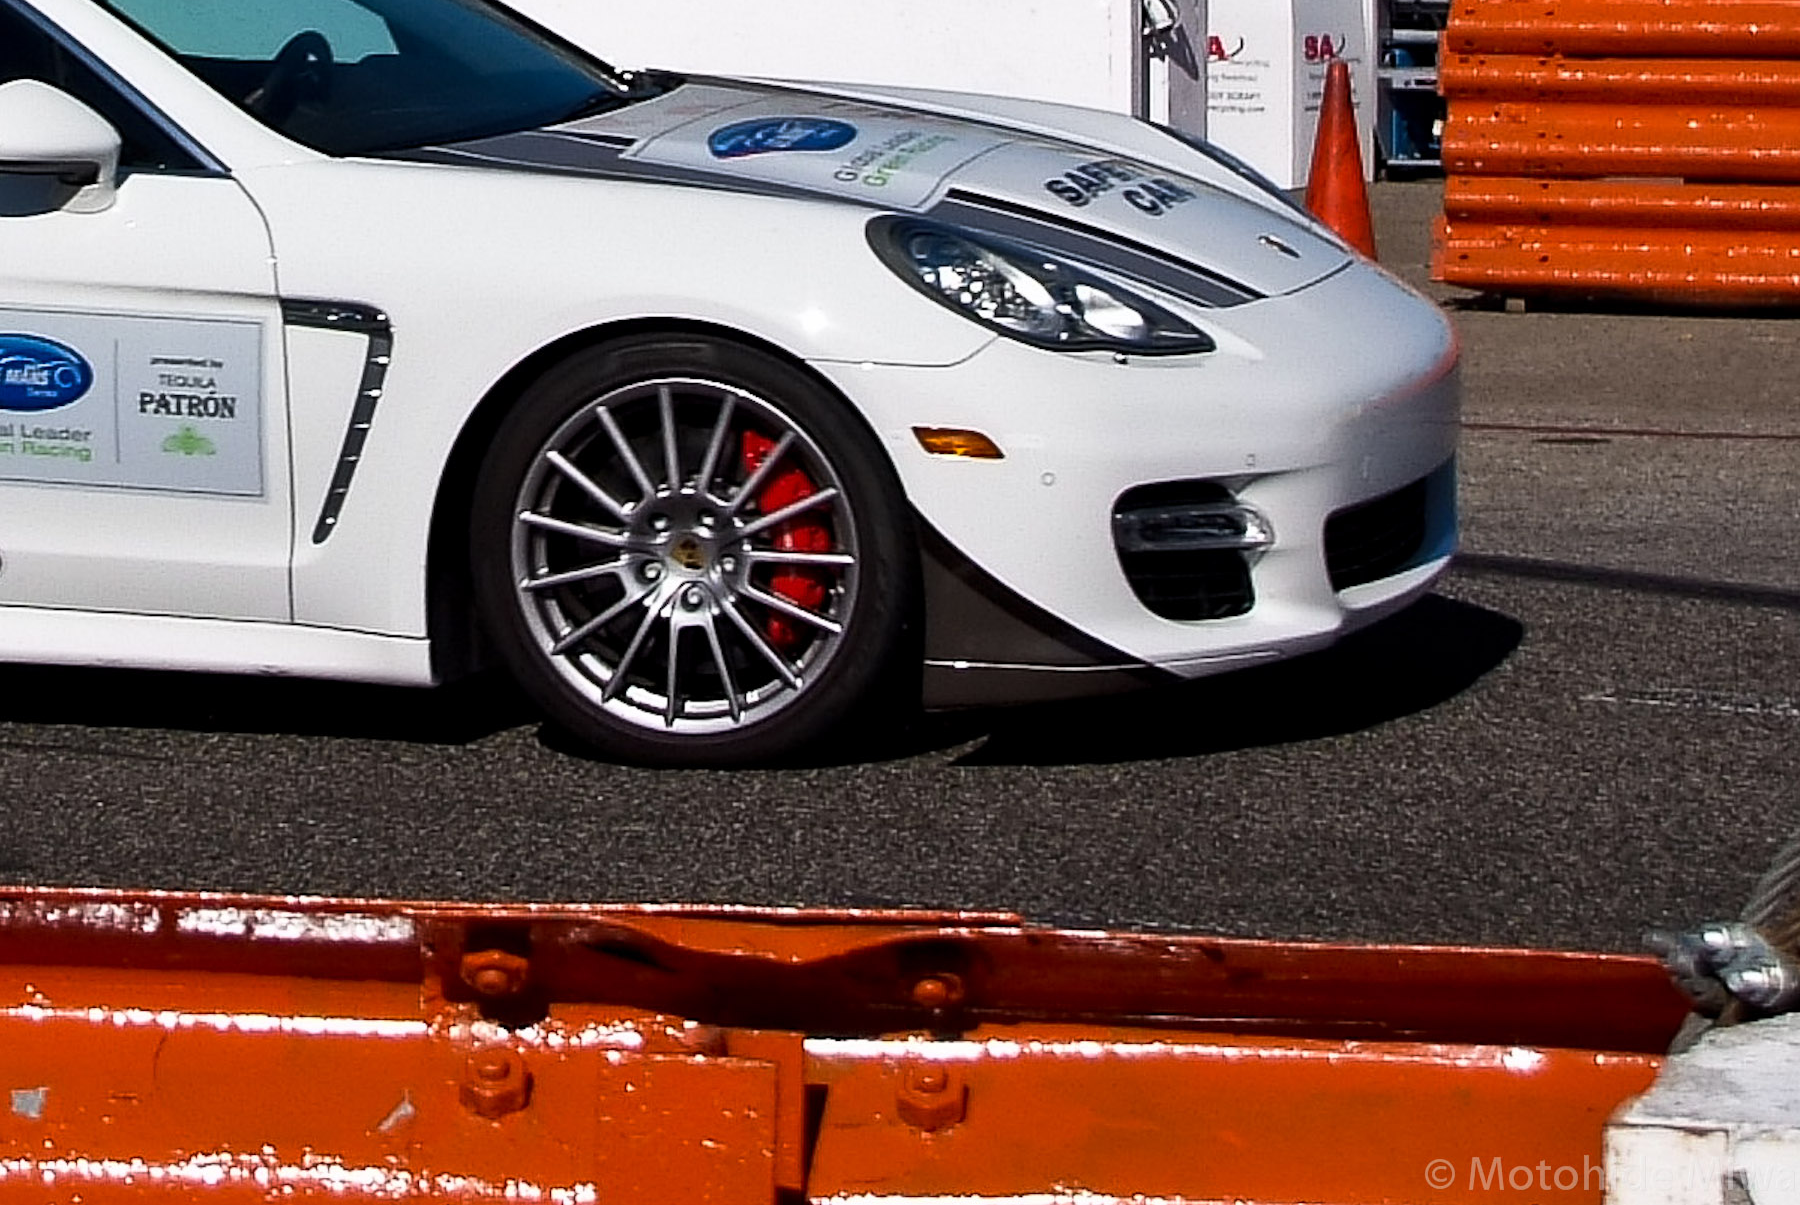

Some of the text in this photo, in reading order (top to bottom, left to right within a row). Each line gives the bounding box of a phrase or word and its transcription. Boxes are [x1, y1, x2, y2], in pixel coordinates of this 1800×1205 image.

[139, 390, 237, 419] PATRÓN
[20, 423, 92, 442] Leader
[22, 440, 92, 462] Racing
